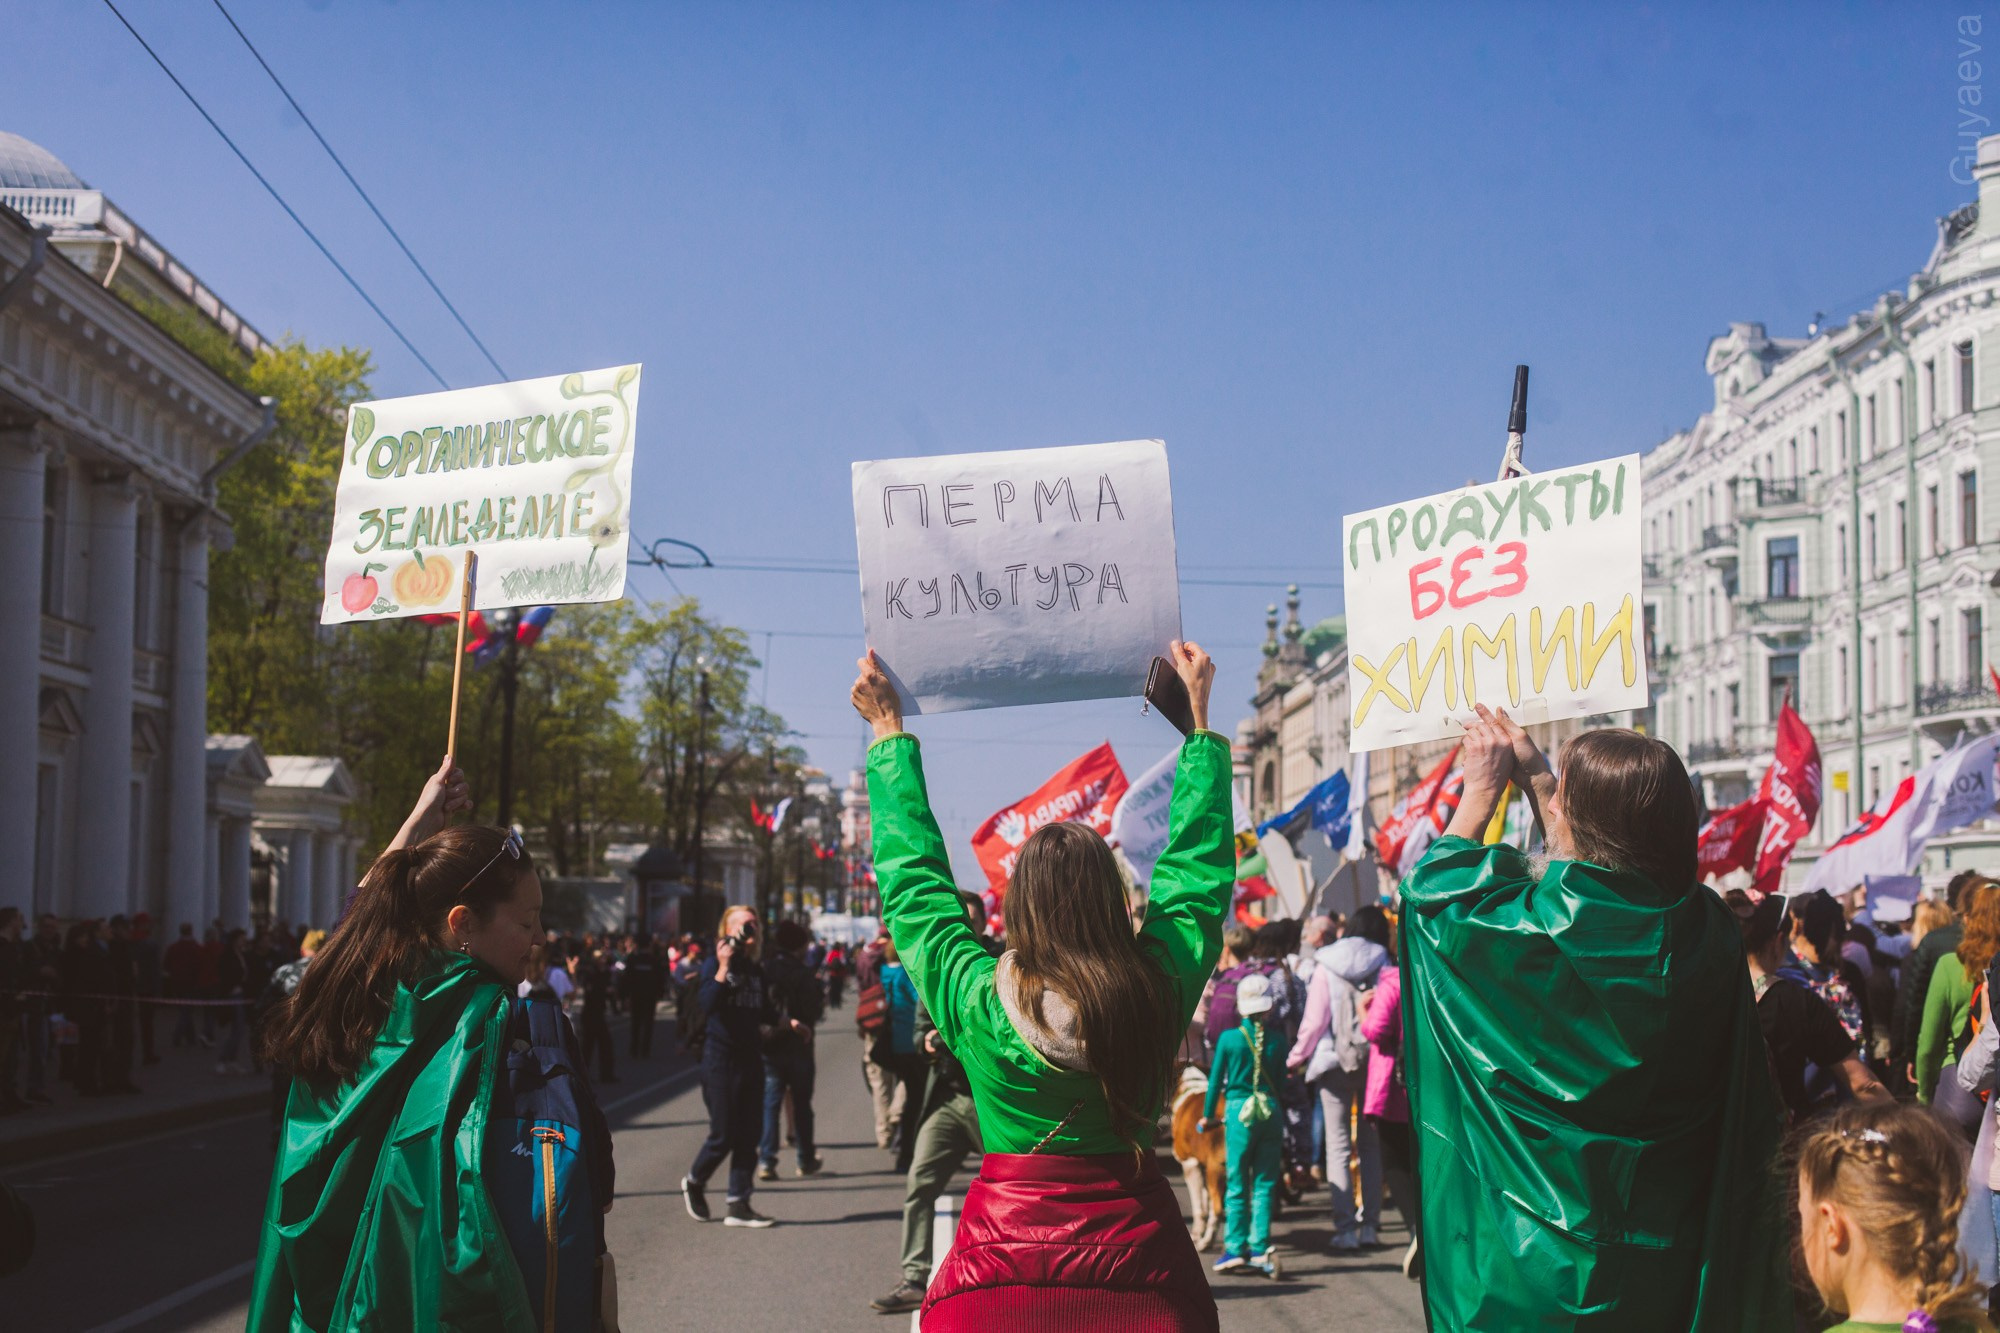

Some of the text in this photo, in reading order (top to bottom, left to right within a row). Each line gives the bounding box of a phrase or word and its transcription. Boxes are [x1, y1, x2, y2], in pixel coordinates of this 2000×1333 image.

[366, 405, 613, 480] ОРГАНИЧЕСКОЕ
[353, 491, 596, 555] ЗЕМЛЕДЕЛИЕ
[883, 473, 1125, 529] ПЕРМА
[1349, 463, 1626, 570] ПРОДУКТЫ
[886, 563, 1128, 619] КУЛЬТУРА
[1409, 541, 1529, 621] БЕЗ
[1352, 593, 1637, 729] ХИМИИ
